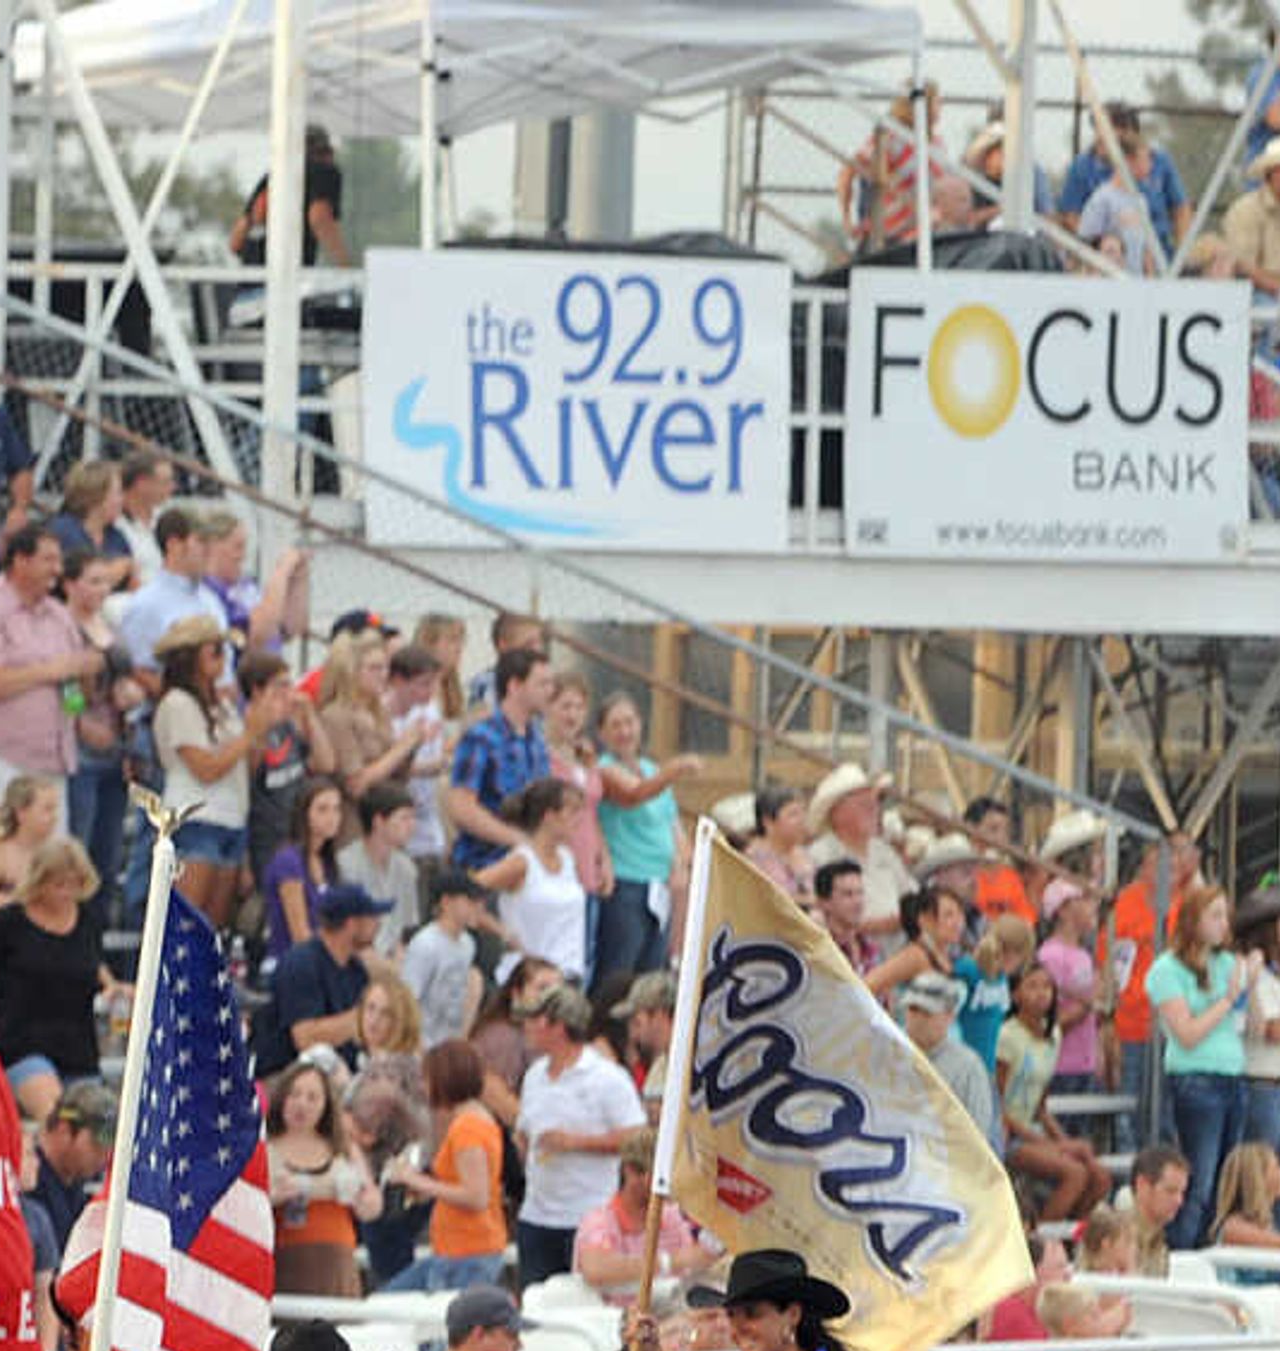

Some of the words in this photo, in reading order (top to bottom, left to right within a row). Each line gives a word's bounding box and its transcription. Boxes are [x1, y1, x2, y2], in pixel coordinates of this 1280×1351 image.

[467, 302, 534, 357] the
[556, 273, 744, 385] 92.9
[872, 303, 1225, 438] FOCUS
[469, 362, 764, 494] River
[1072, 450, 1216, 494] BANK
